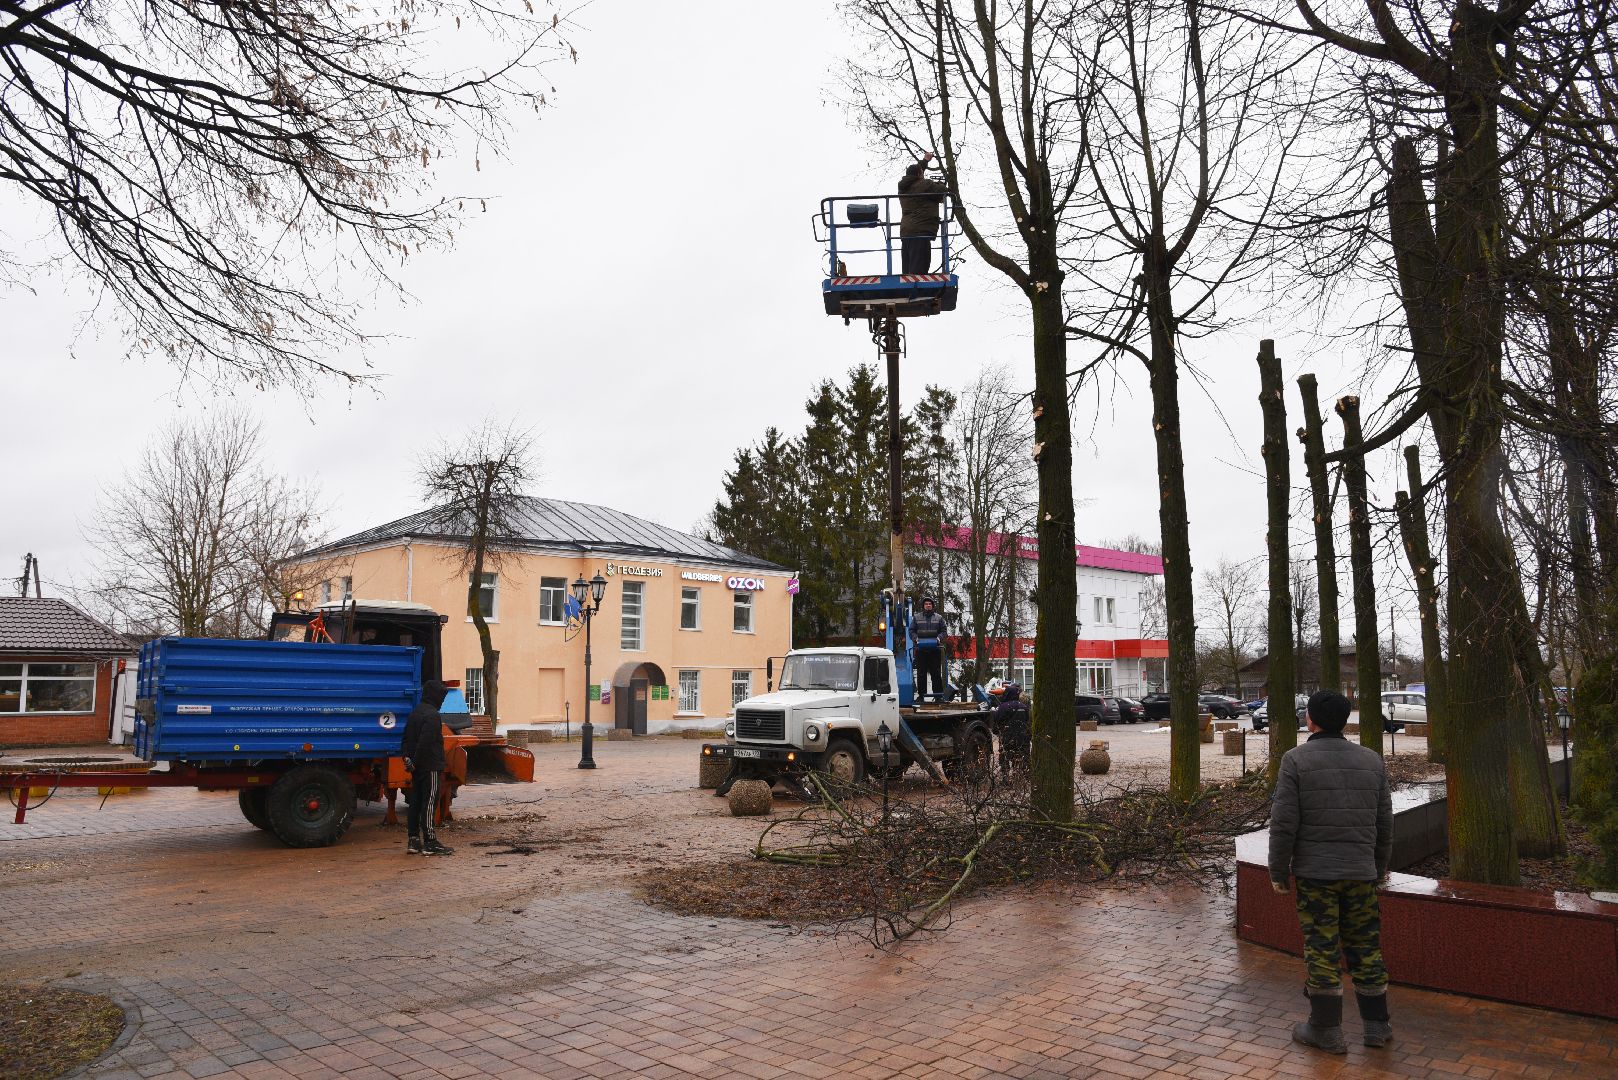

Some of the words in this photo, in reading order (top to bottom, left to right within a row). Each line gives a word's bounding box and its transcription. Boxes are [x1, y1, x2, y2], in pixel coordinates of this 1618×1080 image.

[617, 565, 663, 577] ГЕОДЕЗИЯ
[681, 571, 723, 583] WILDBERRIES
[727, 576, 765, 590] OZON
